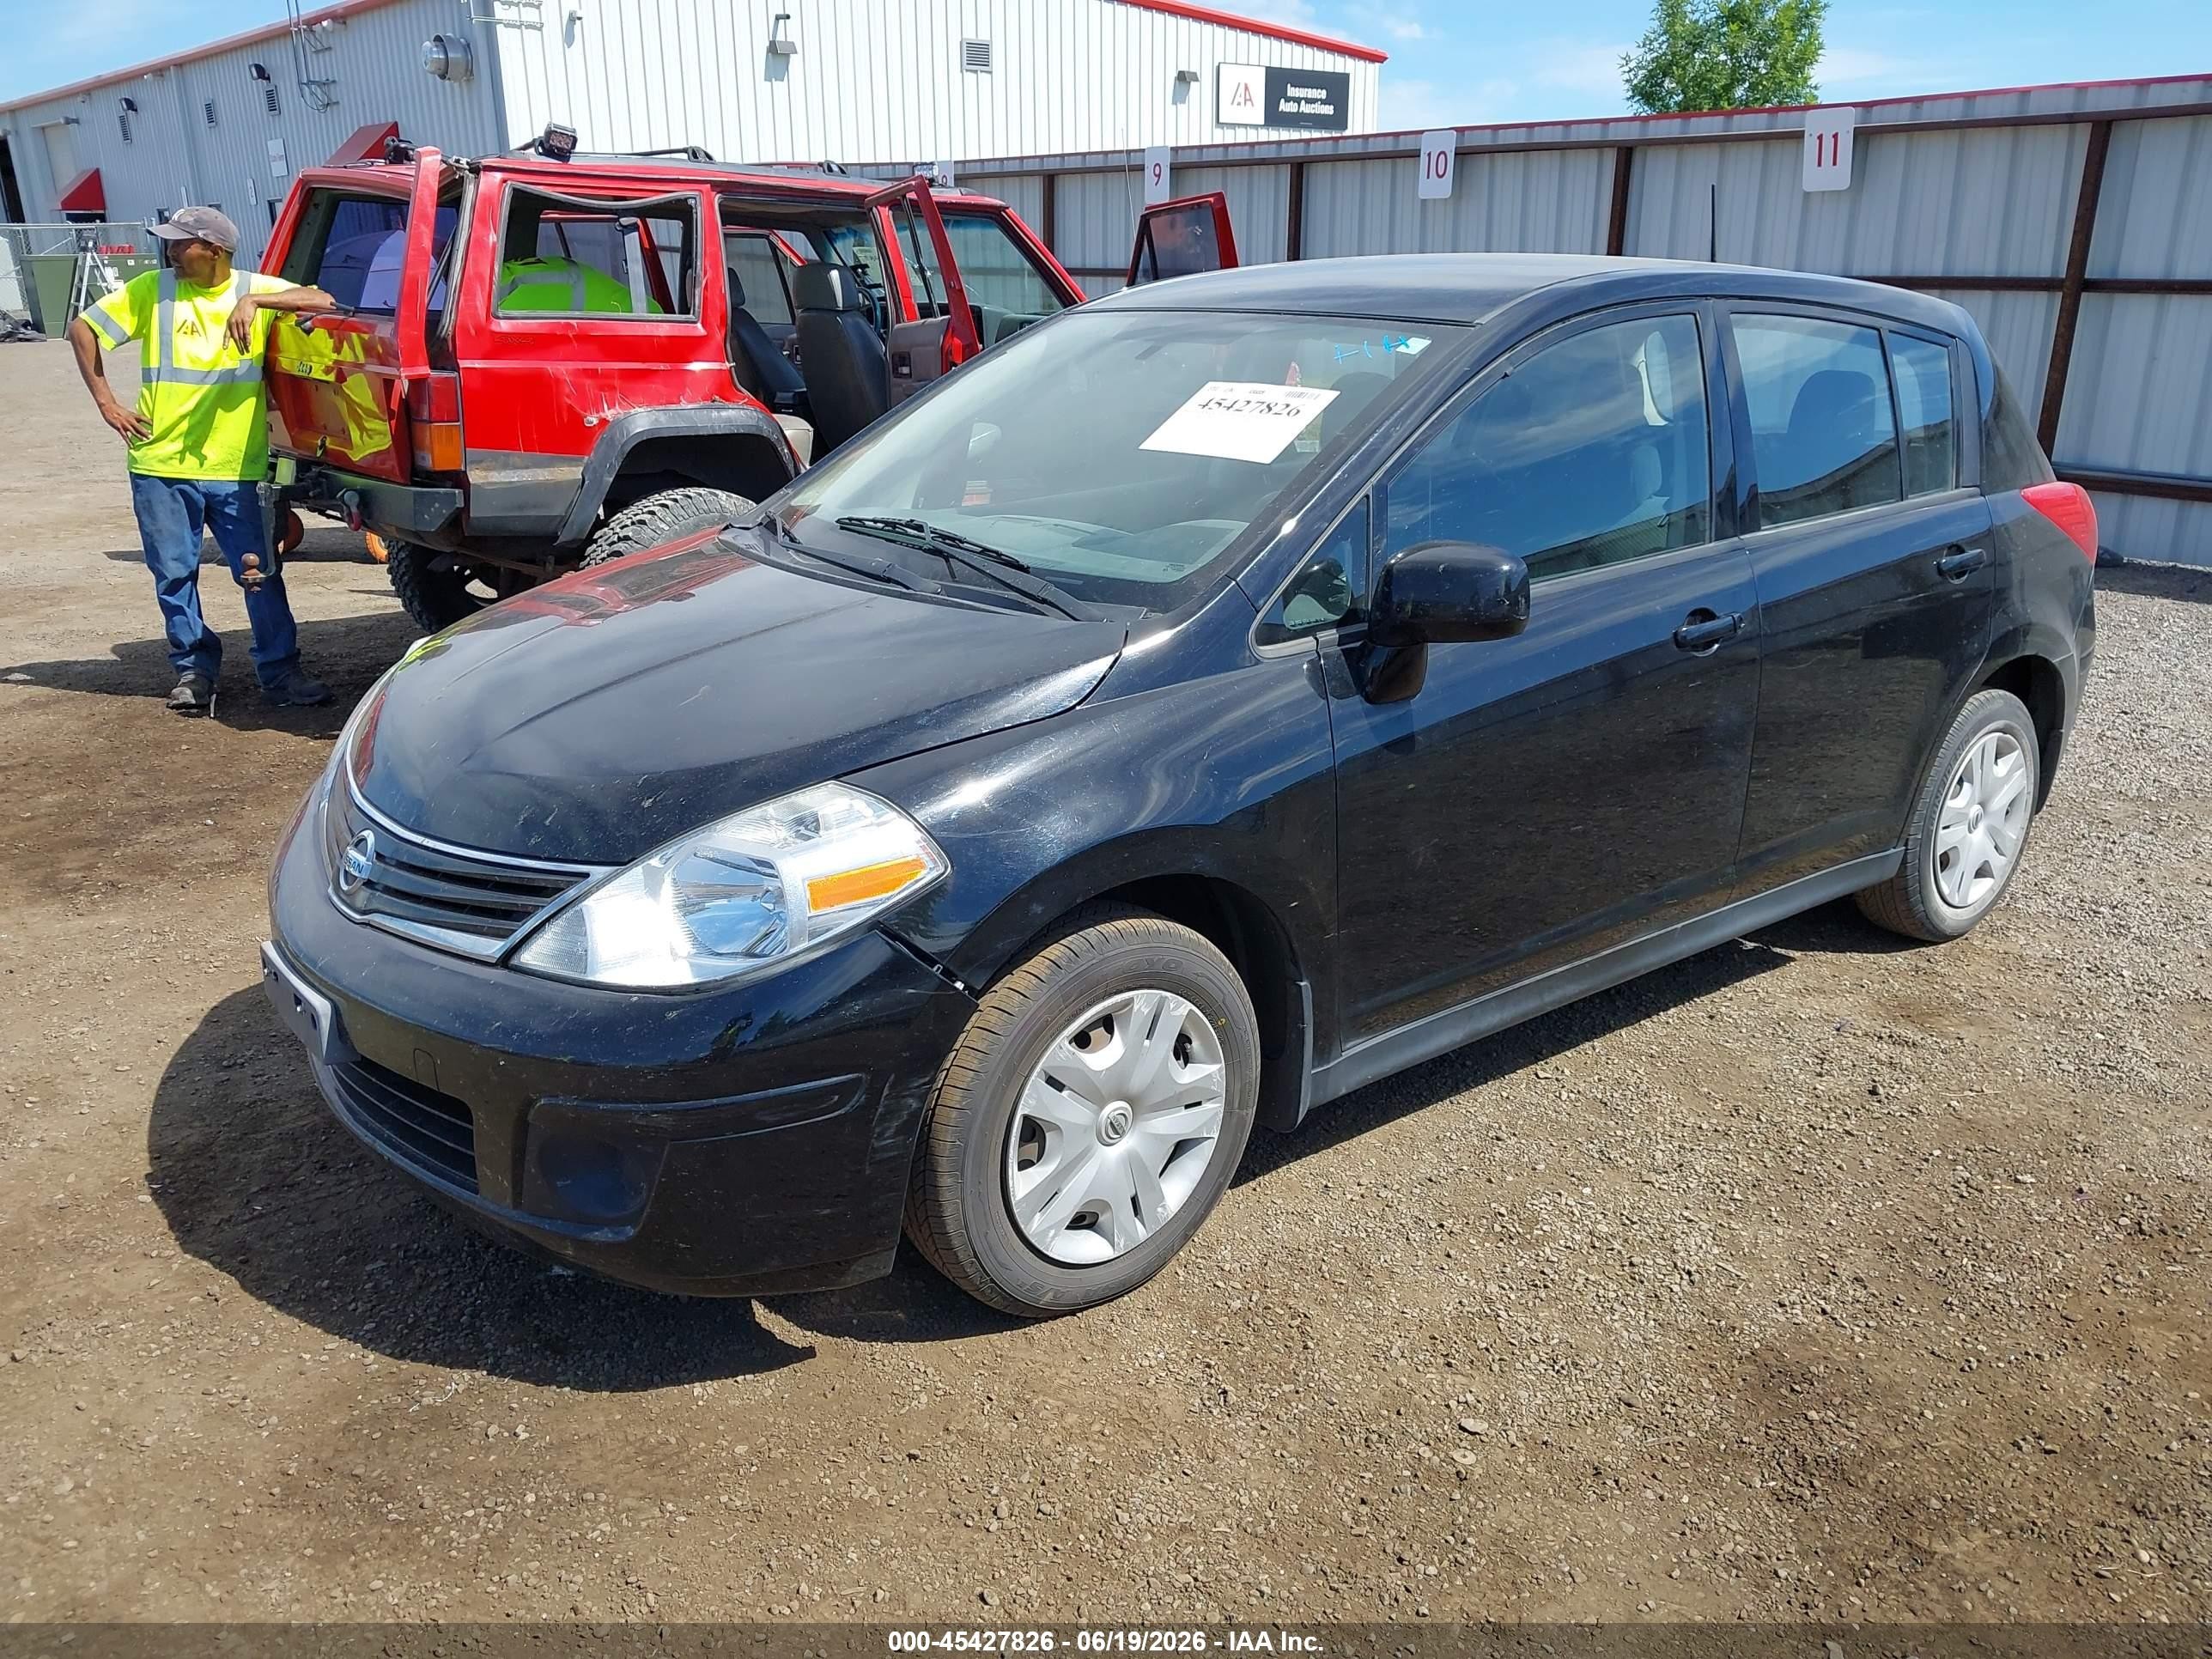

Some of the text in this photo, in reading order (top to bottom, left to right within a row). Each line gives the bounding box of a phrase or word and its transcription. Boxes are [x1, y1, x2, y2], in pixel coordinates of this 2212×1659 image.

[1286, 83, 1328, 100] Insurance
[1278, 98, 1334, 115] Auto Auctions
[1817, 131, 1839, 167] 11
[1152, 162, 1162, 186] 9
[1426, 150, 1448, 179] 10
[1198, 398, 1306, 417] 45427826
